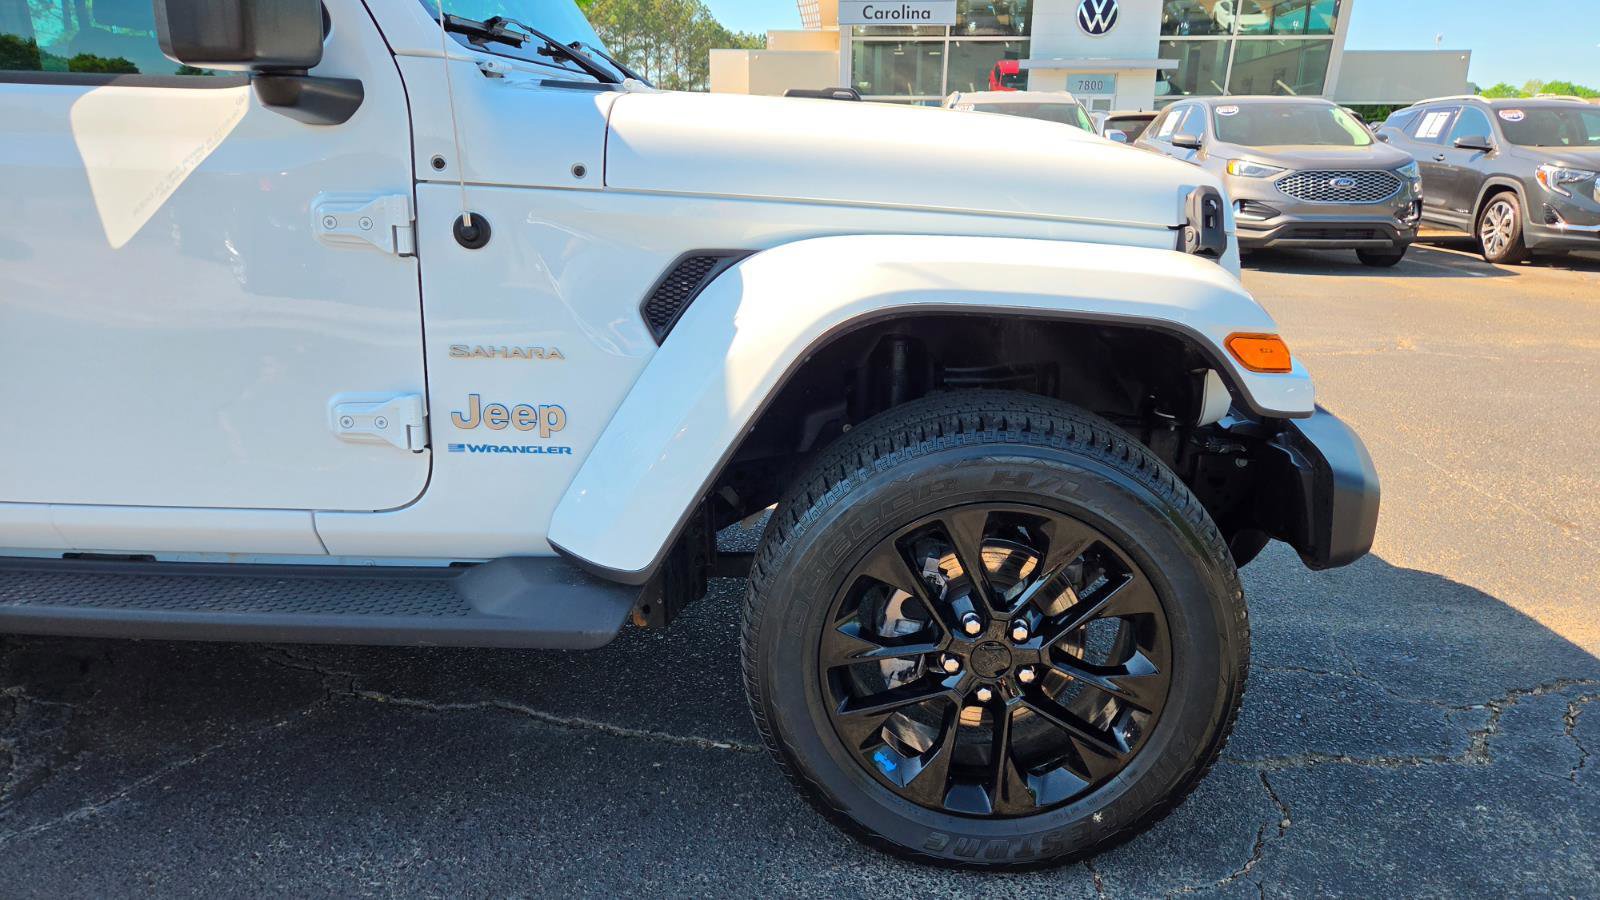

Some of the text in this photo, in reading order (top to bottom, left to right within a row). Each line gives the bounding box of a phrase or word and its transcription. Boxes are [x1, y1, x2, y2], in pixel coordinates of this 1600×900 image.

[863, 5, 931, 21] Carolina
[1079, 0, 1117, 35] VW
[1077, 79, 1104, 91] 7800
[449, 344, 566, 360] SAHARA
[450, 393, 567, 438] Jeep
[466, 443, 573, 455] WRANGLER
